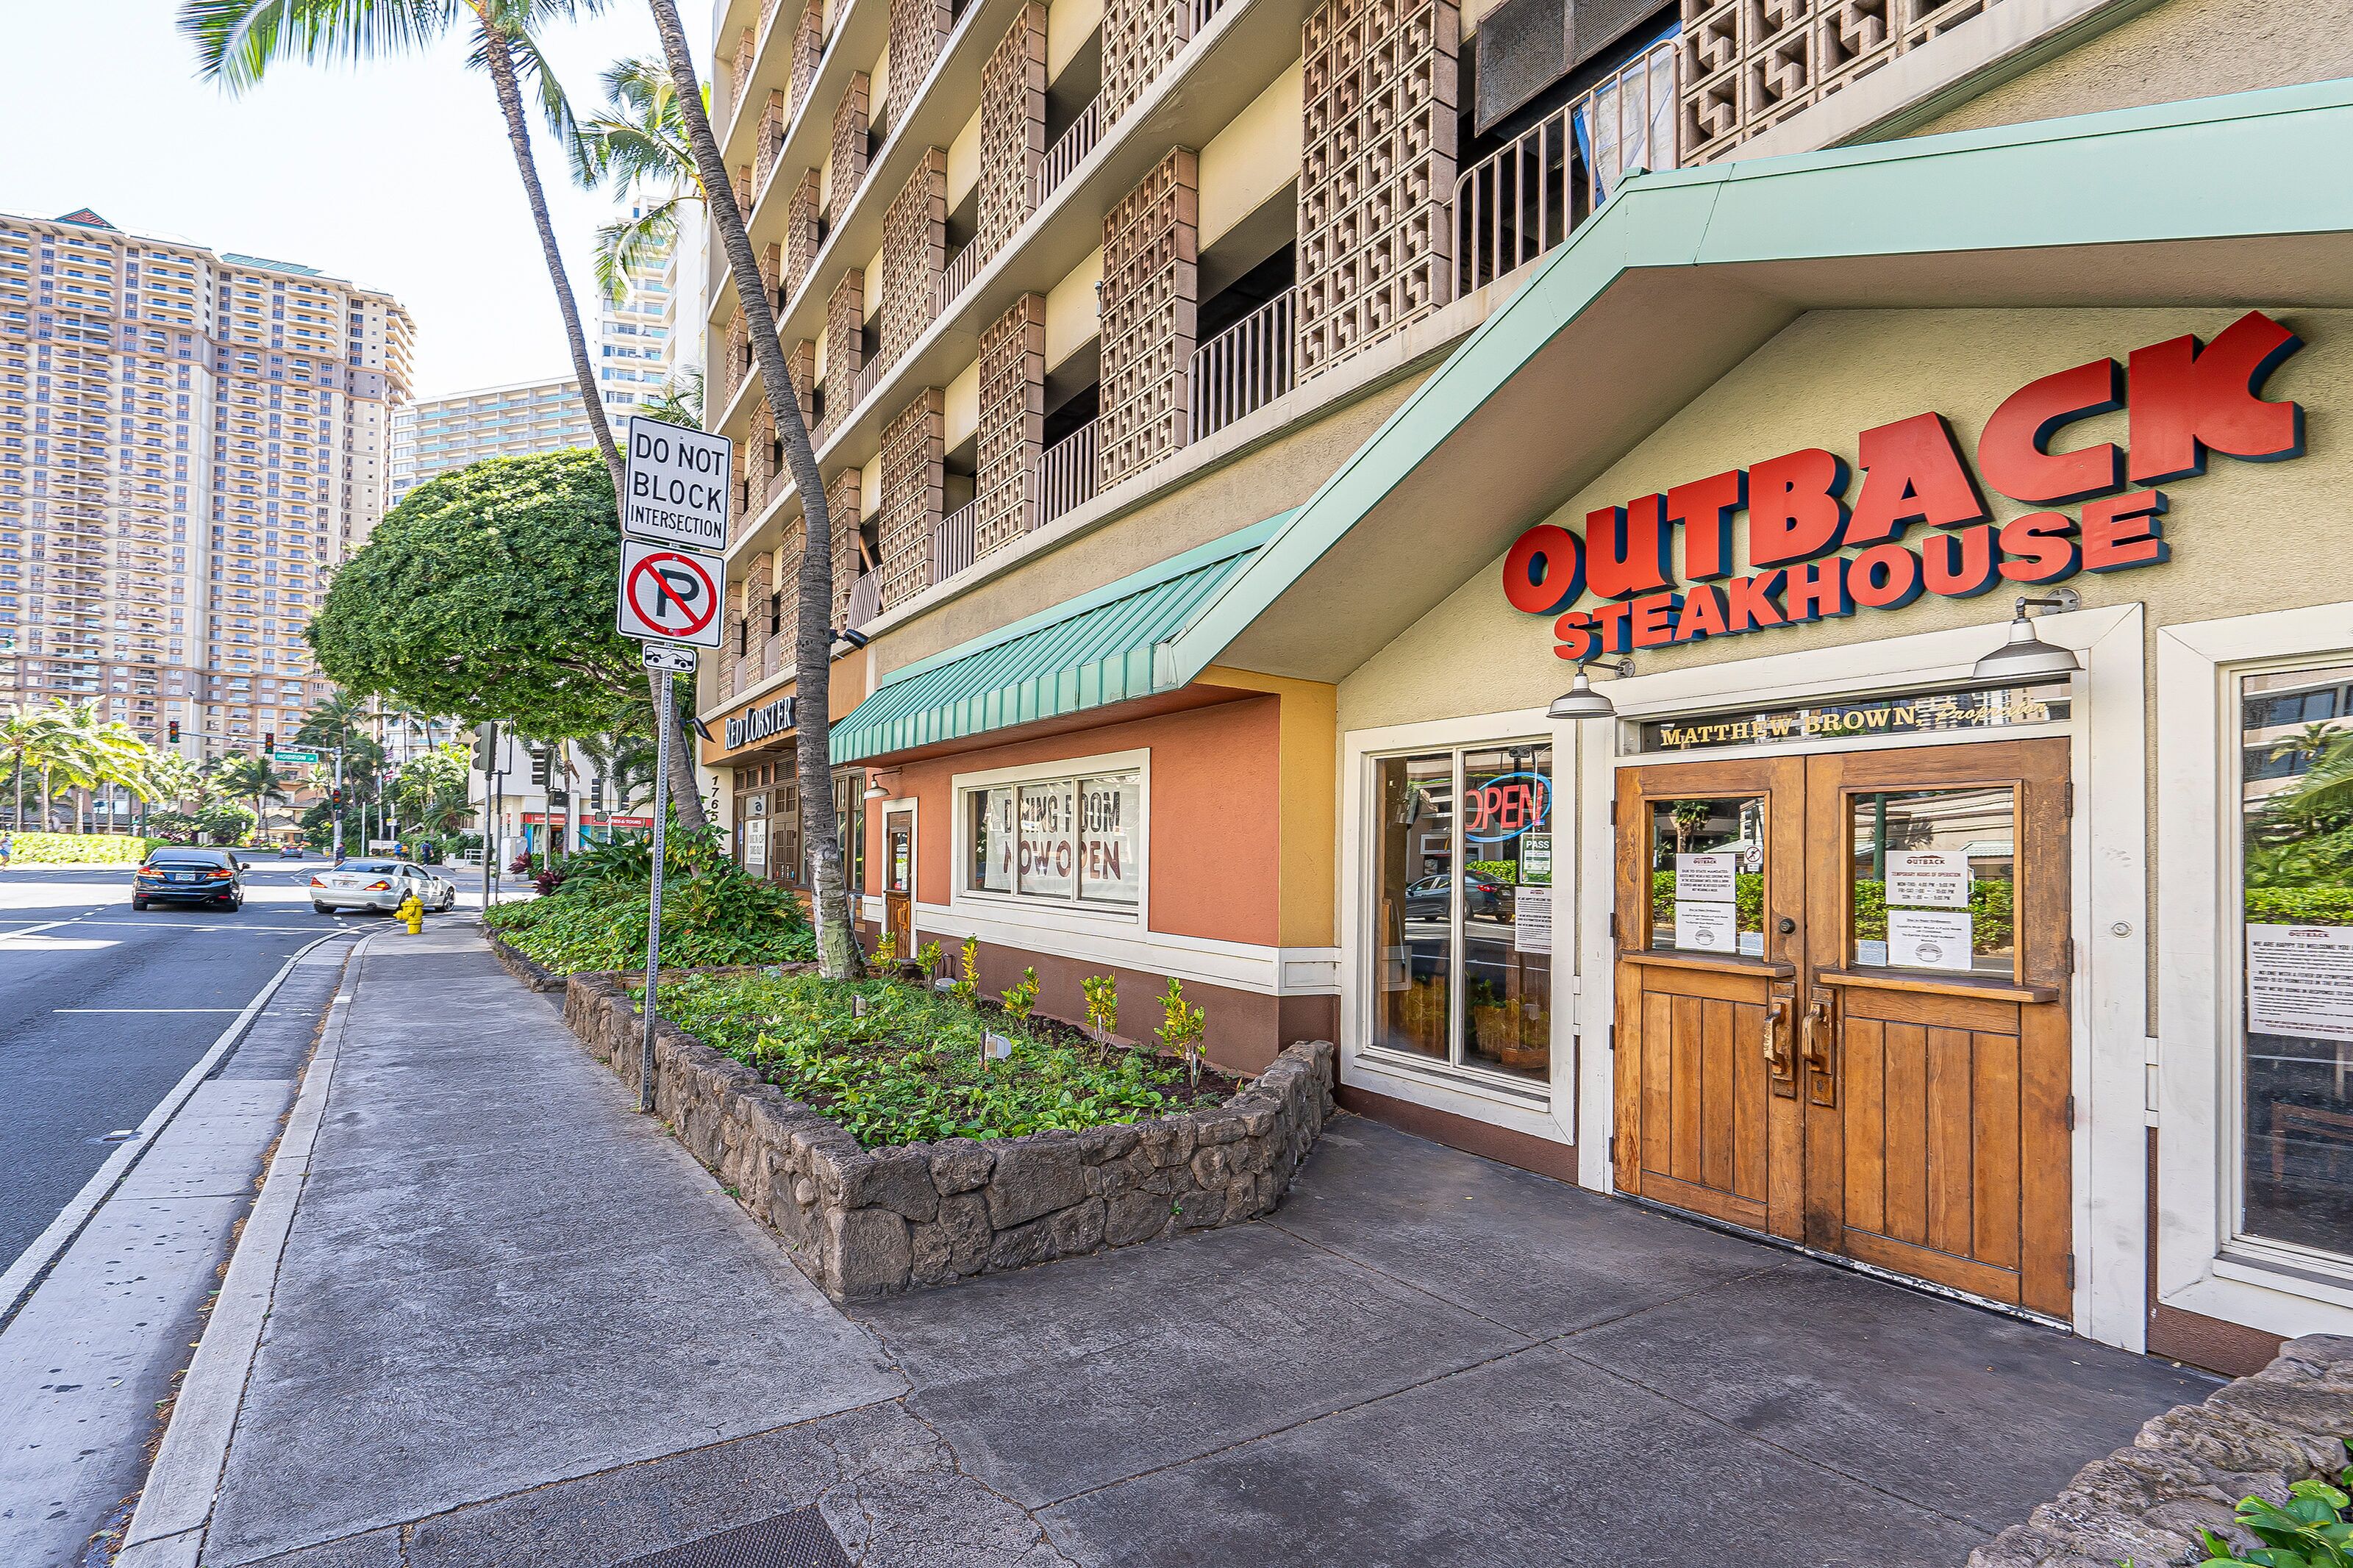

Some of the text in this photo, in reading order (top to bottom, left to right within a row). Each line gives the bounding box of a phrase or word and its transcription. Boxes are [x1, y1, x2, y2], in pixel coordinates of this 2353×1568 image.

[635, 432, 725, 476] DO NOT
[1502, 310, 2304, 616] OUTBACK
[633, 470, 723, 514] BLOCK
[630, 504, 722, 539] INTERSECTION
[1553, 490, 2169, 662] STEAKHOUSE
[725, 696, 794, 750] RED LOBSTER
[1660, 700, 2047, 746] MATTHEW BROWN, Proprietor
[1465, 782, 1543, 831] OPEN
[1526, 840, 1550, 849] PASS
